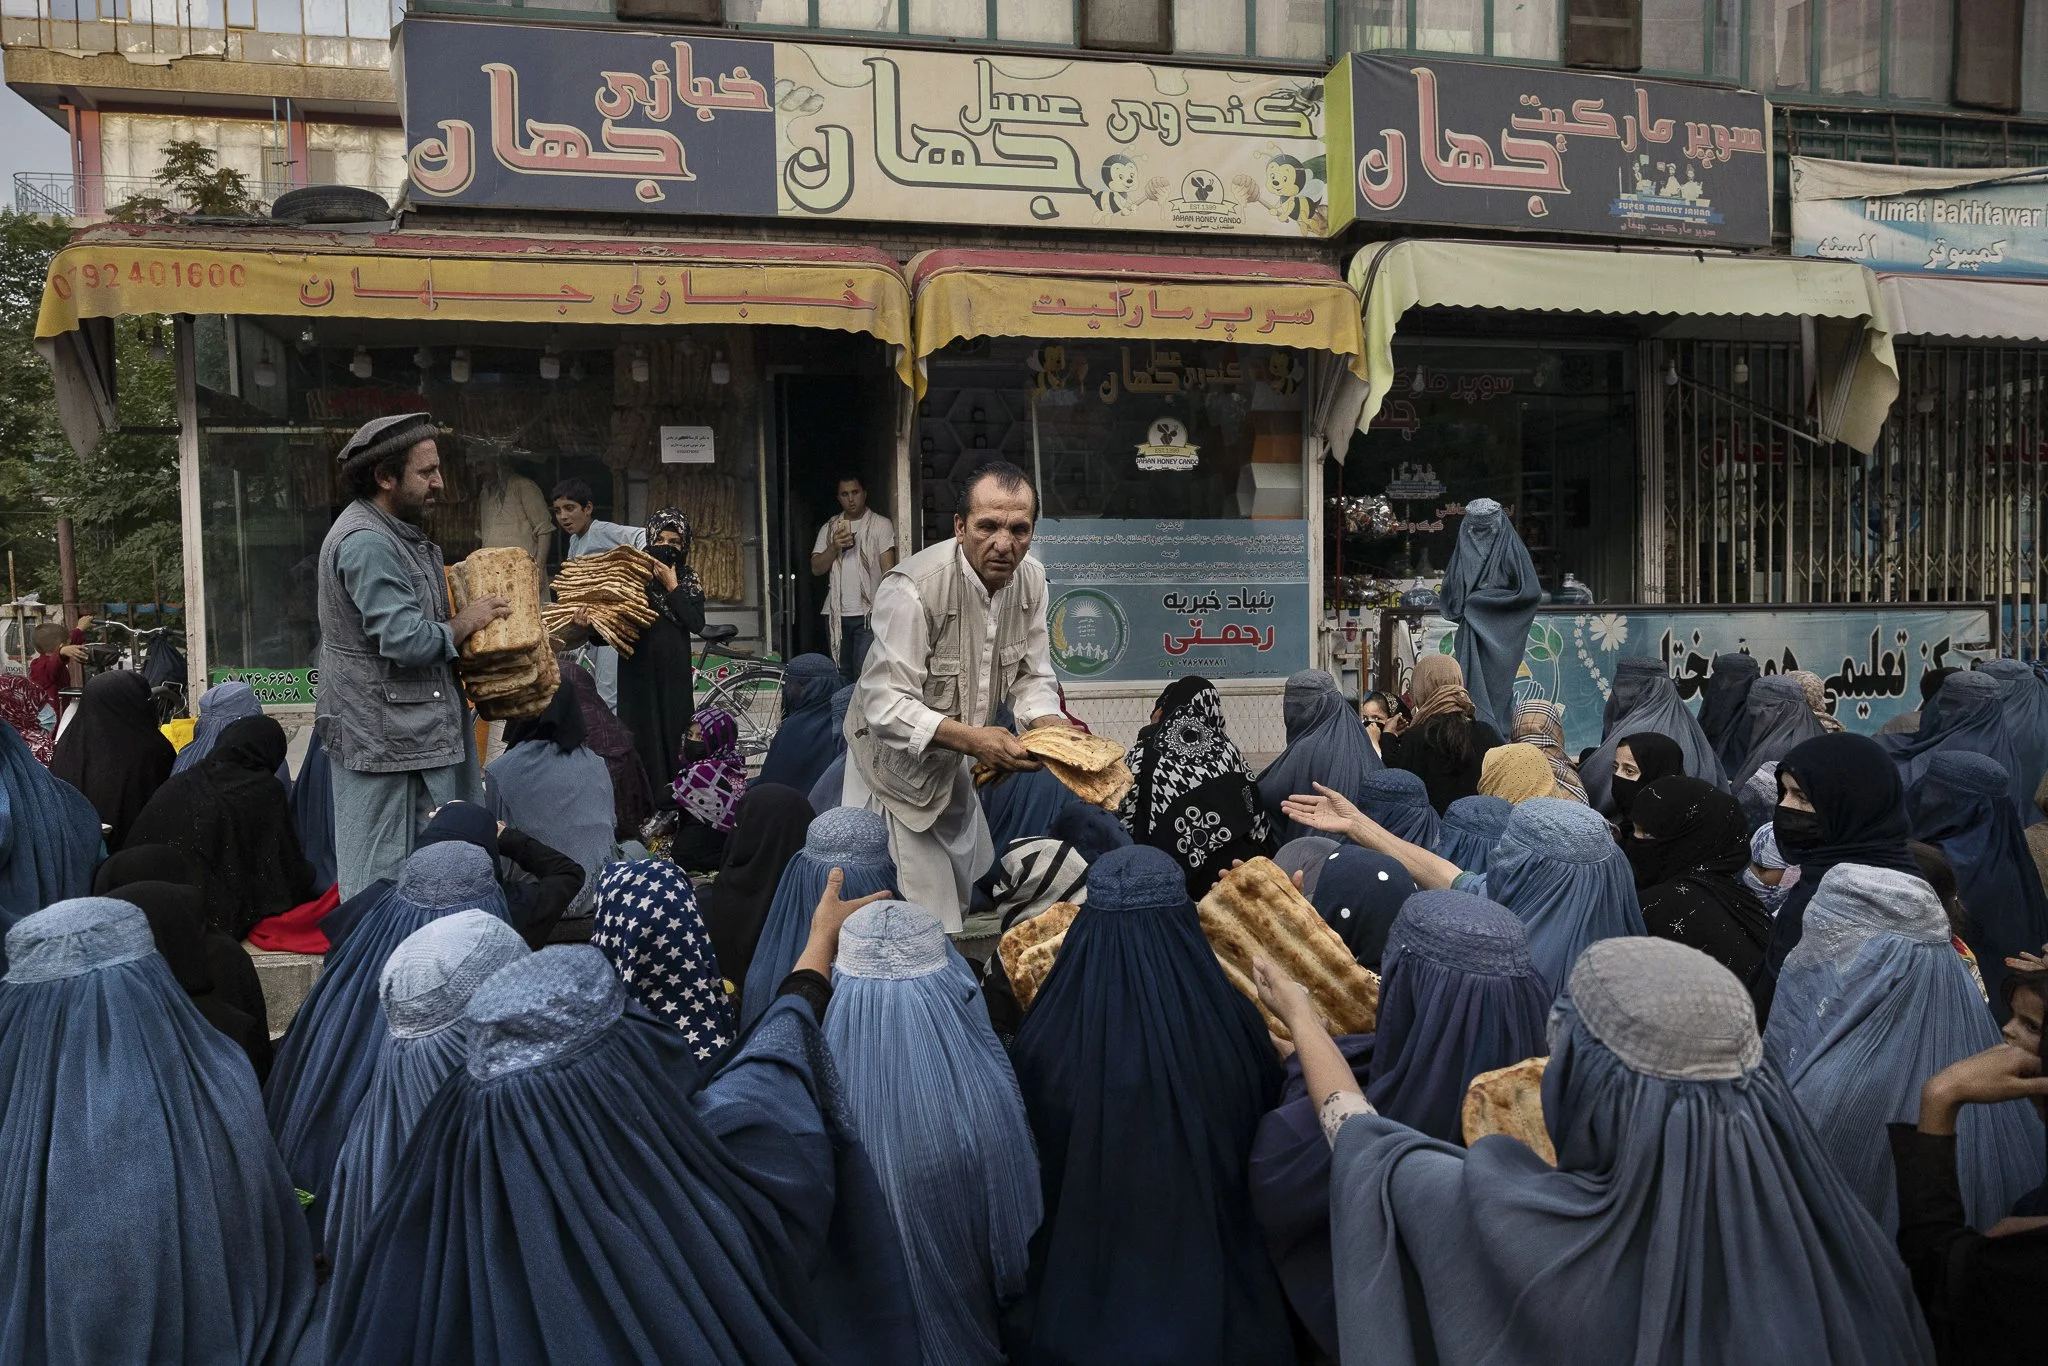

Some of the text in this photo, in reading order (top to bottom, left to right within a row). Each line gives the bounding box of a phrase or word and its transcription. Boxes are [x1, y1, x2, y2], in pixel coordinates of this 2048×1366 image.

[595, 40, 773, 122] خبازی
[959, 57, 1318, 146] کندوی عسل
[408, 62, 697, 203] جهان
[783, 56, 1093, 221] جهان
[1358, 66, 1571, 218] جهان
[1511, 88, 1766, 169] سوپر مارکیت
[1172, 214, 1242, 225] JAHAN HONEY CANDO
[1618, 202, 1711, 217] SUPER MARKET JAHAN
[1864, 198, 2042, 228] Himat Bakhtawar
[1162, 586, 1275, 615] بنیاد خیریه
[1163, 618, 1275, 656] رحمتی
